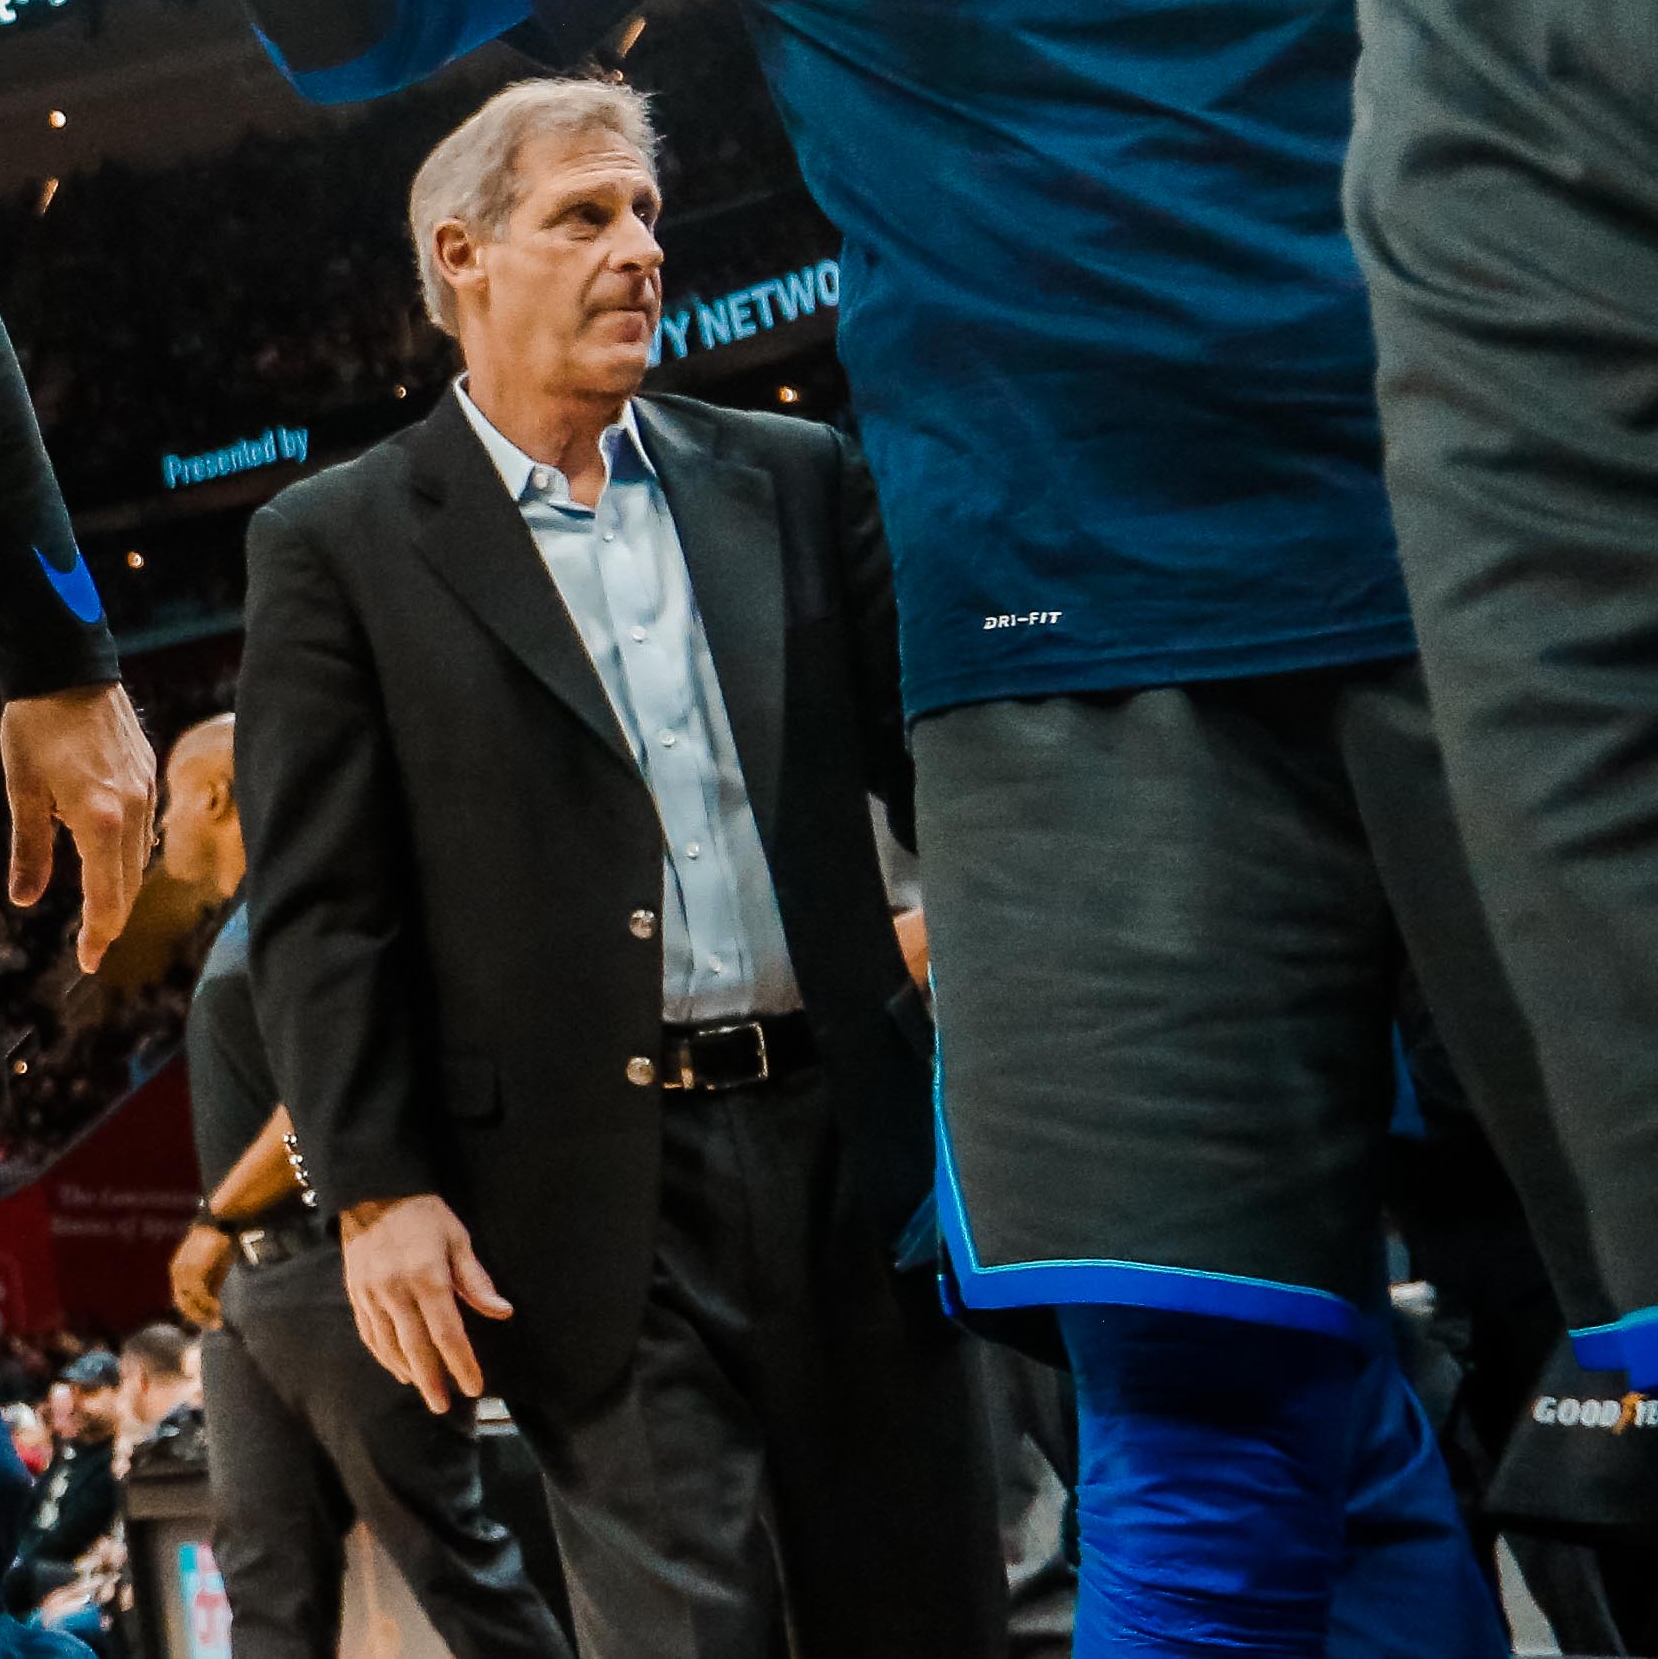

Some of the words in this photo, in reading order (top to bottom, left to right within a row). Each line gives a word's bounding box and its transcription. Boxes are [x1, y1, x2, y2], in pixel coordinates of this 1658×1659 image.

[163, 429, 277, 489] Presented
[277, 425, 308, 463] by
[983, 611, 1062, 630] DRI-FIT
